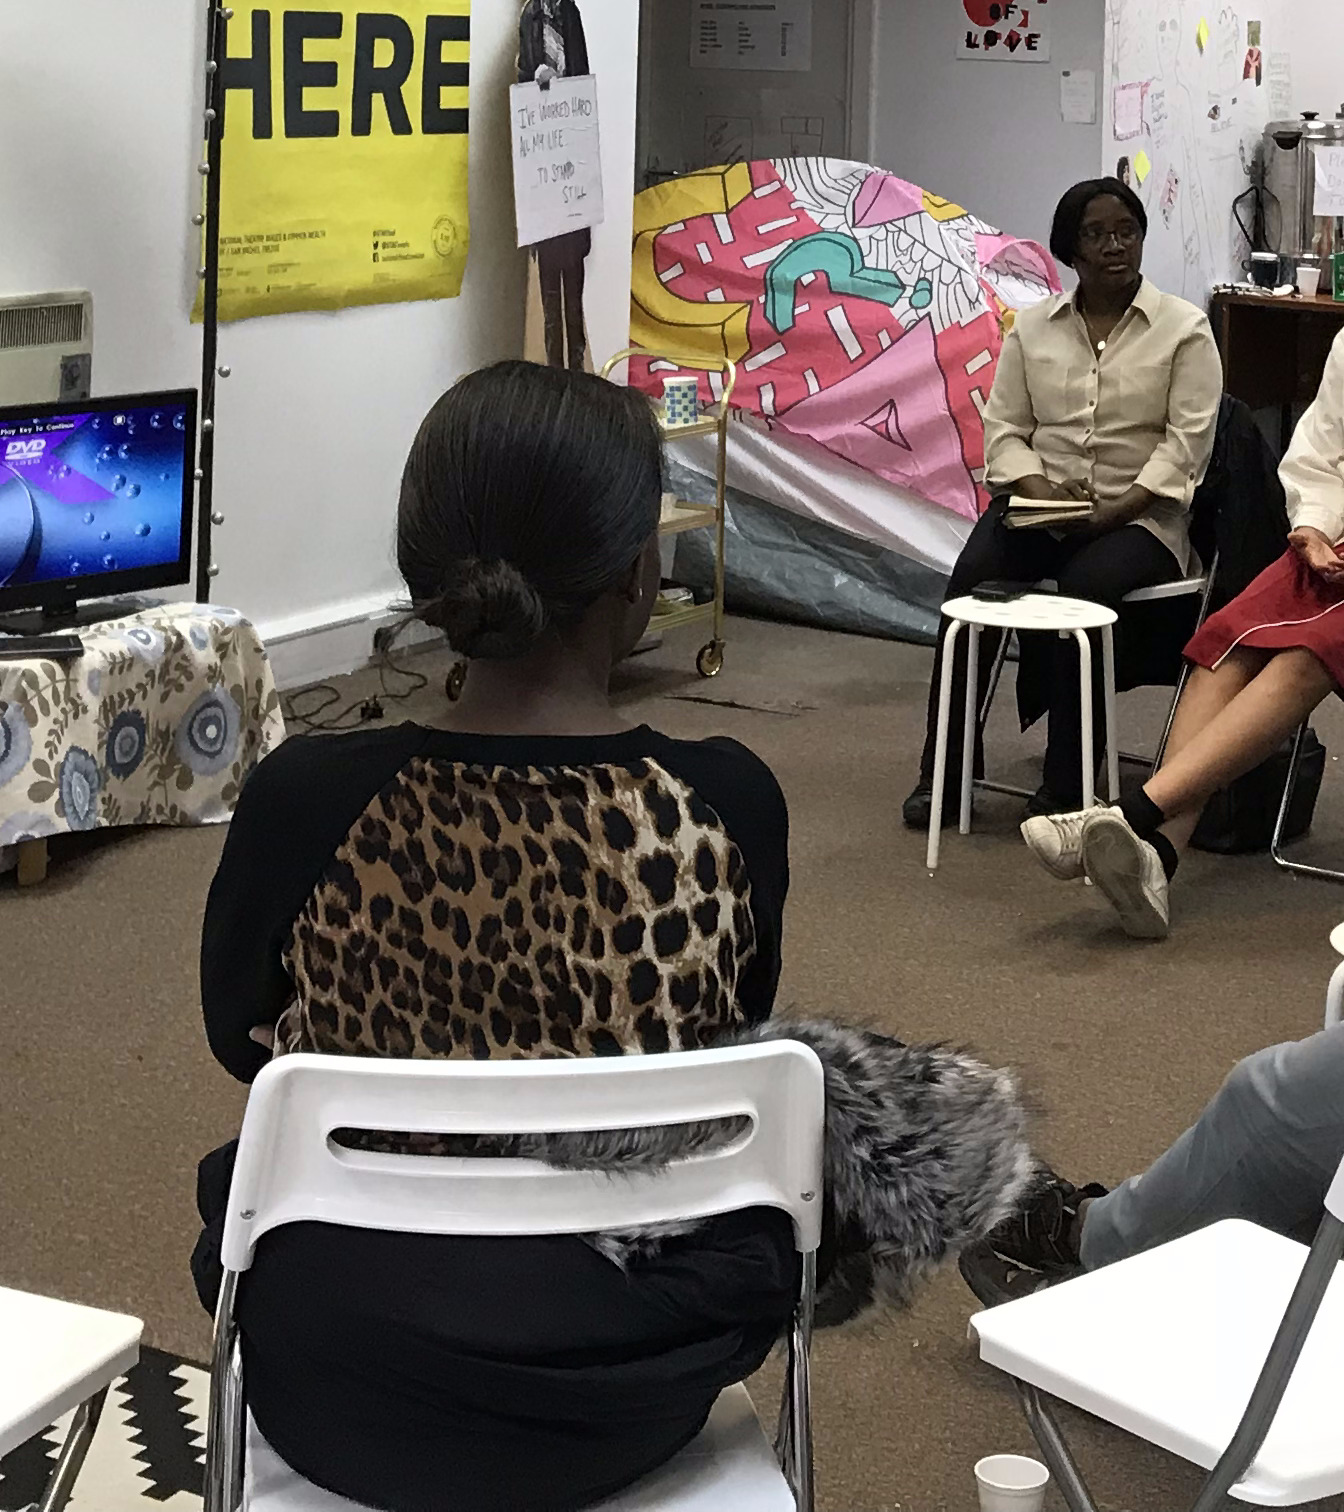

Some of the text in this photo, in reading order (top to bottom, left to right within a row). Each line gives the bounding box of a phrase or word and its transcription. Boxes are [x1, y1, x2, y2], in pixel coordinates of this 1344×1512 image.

[989, 3, 1018, 21] OF
[965, 30, 1041, 53] LOVE
[220, 9, 470, 139] HERE
[518, 96, 592, 129] I'VE WORKED HARD
[519, 129, 564, 157] ALL MY LIFE
[537, 160, 575, 184] TO STAND
[562, 185, 587, 203] STILL
[5, 438, 47, 456] DVD
